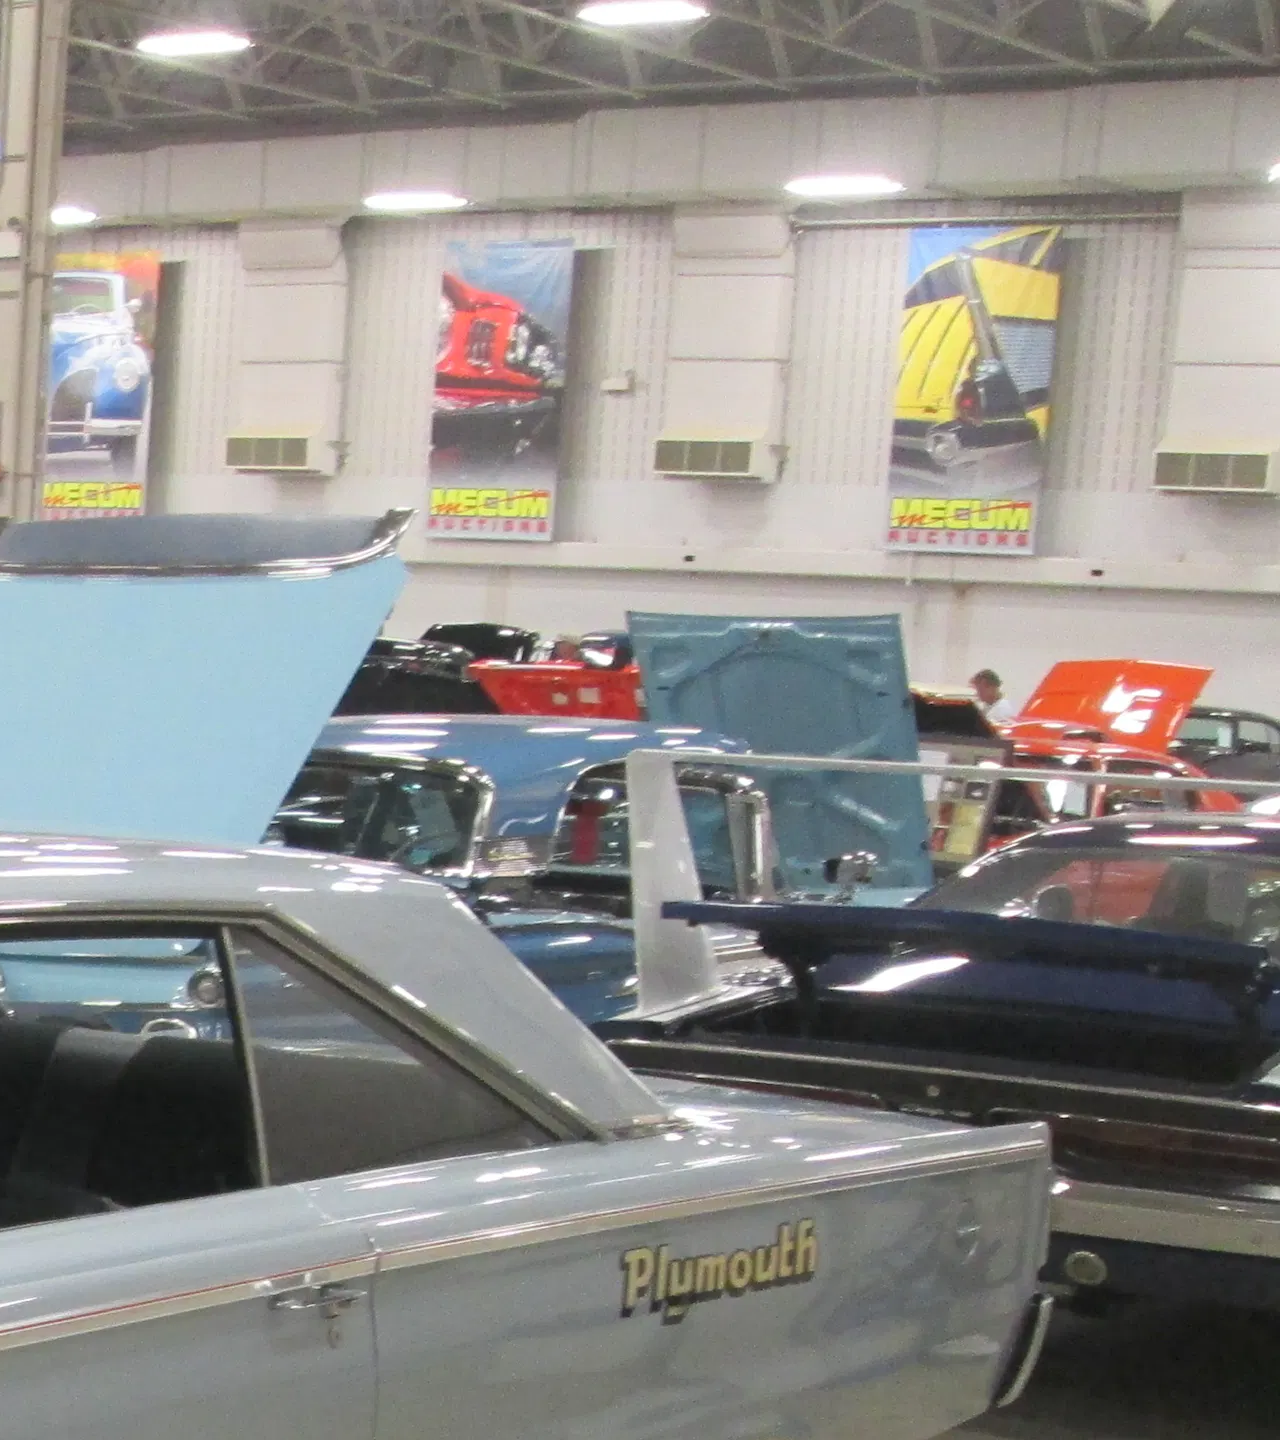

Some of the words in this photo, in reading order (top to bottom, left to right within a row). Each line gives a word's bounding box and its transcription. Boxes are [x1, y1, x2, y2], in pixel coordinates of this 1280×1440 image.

[42, 481, 143, 509] MECUM
[430, 487, 550, 519] MECUM
[891, 498, 1032, 531] MECUM
[888, 530, 1030, 547] AUCTIONS
[621, 1216, 819, 1325] Plymouth
